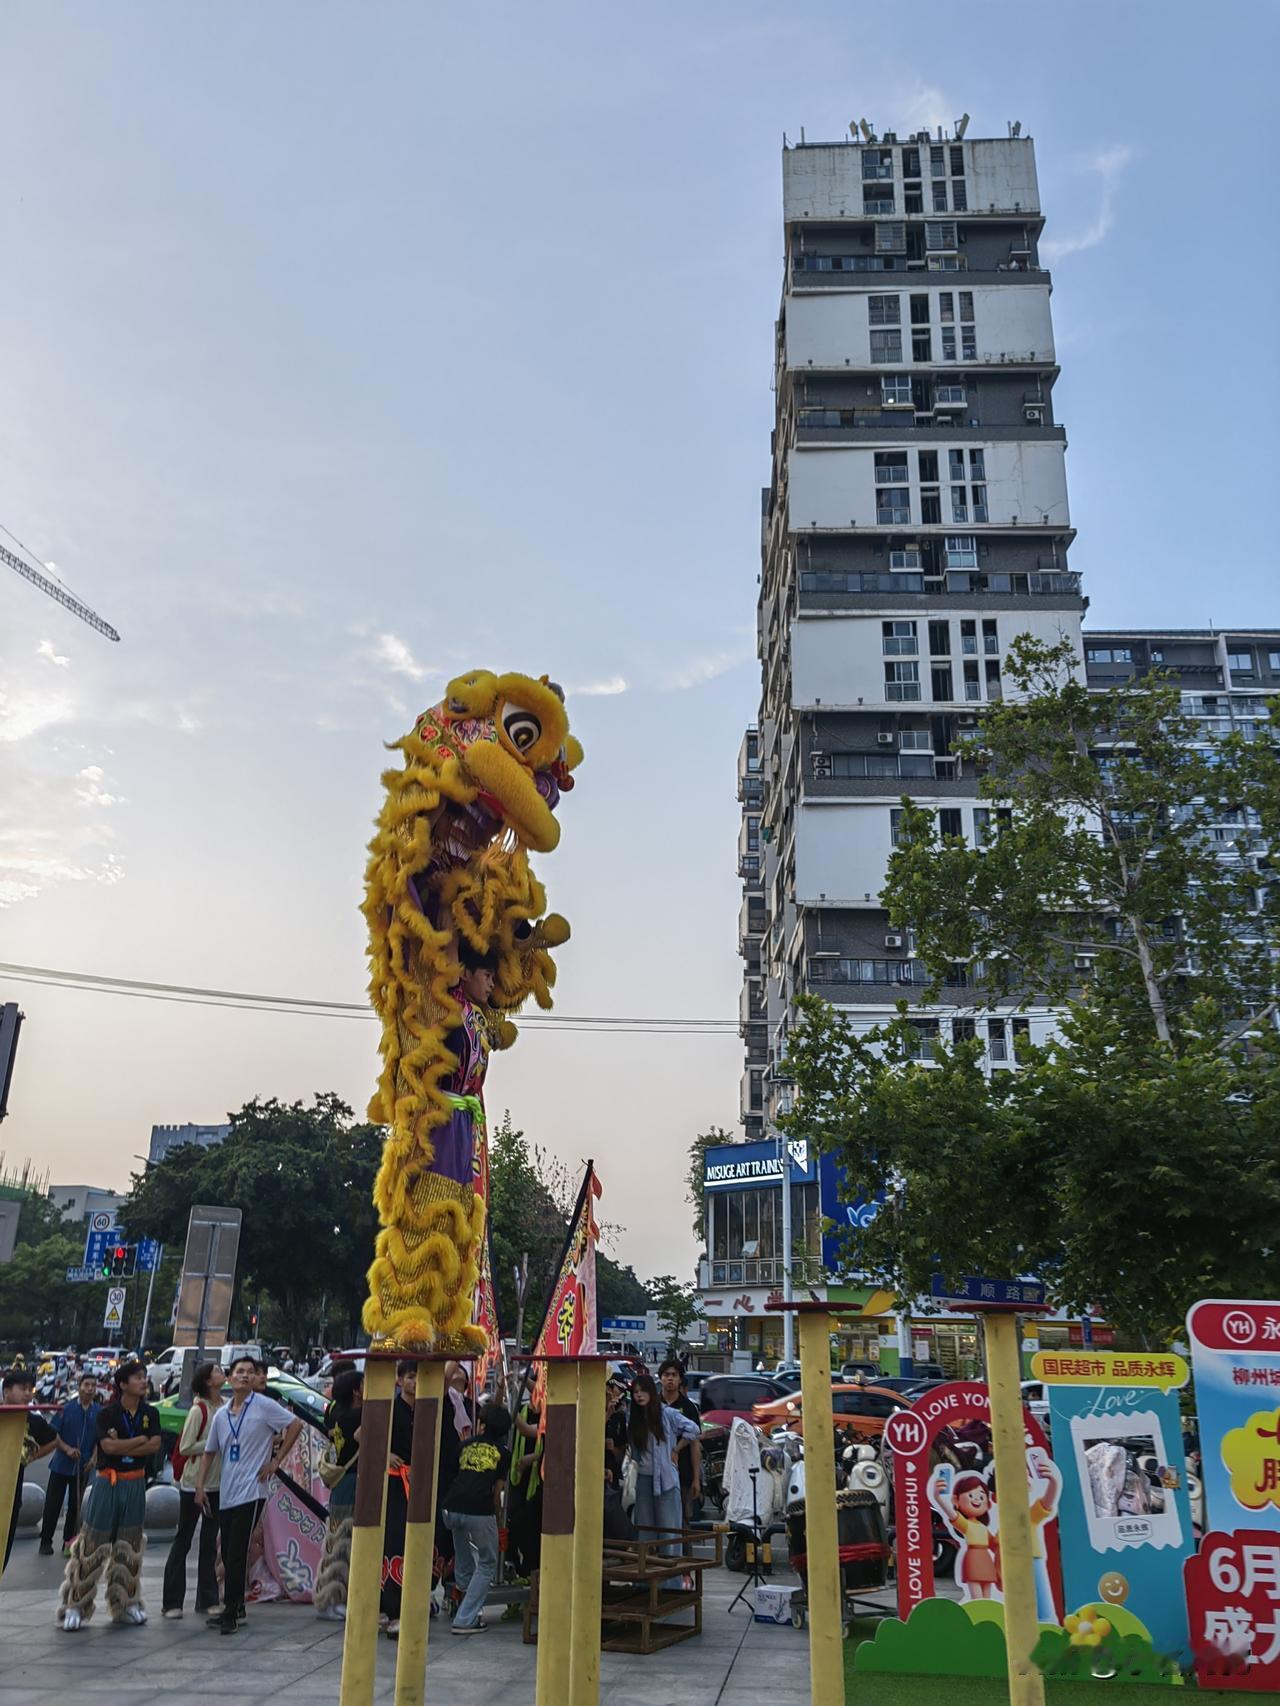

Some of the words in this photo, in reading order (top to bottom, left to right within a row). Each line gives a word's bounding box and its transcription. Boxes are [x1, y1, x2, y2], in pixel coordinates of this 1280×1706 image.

[707, 1164, 735, 1180] MISUGE
[736, 1161, 750, 1177] ART
[111, 1292, 122, 1302] 30
[1229, 1320, 1250, 1335] YH
[1043, 1359, 1106, 1376] 国民超市
[1112, 1360, 1176, 1377] 品质永辉
[922, 1394, 960, 1421] LOVE
[1083, 1387, 1138, 1413] Love
[892, 1423, 920, 1443] YH
[905, 1478, 920, 1552] YONGHUI
[908, 1558, 922, 1599] LOVE
